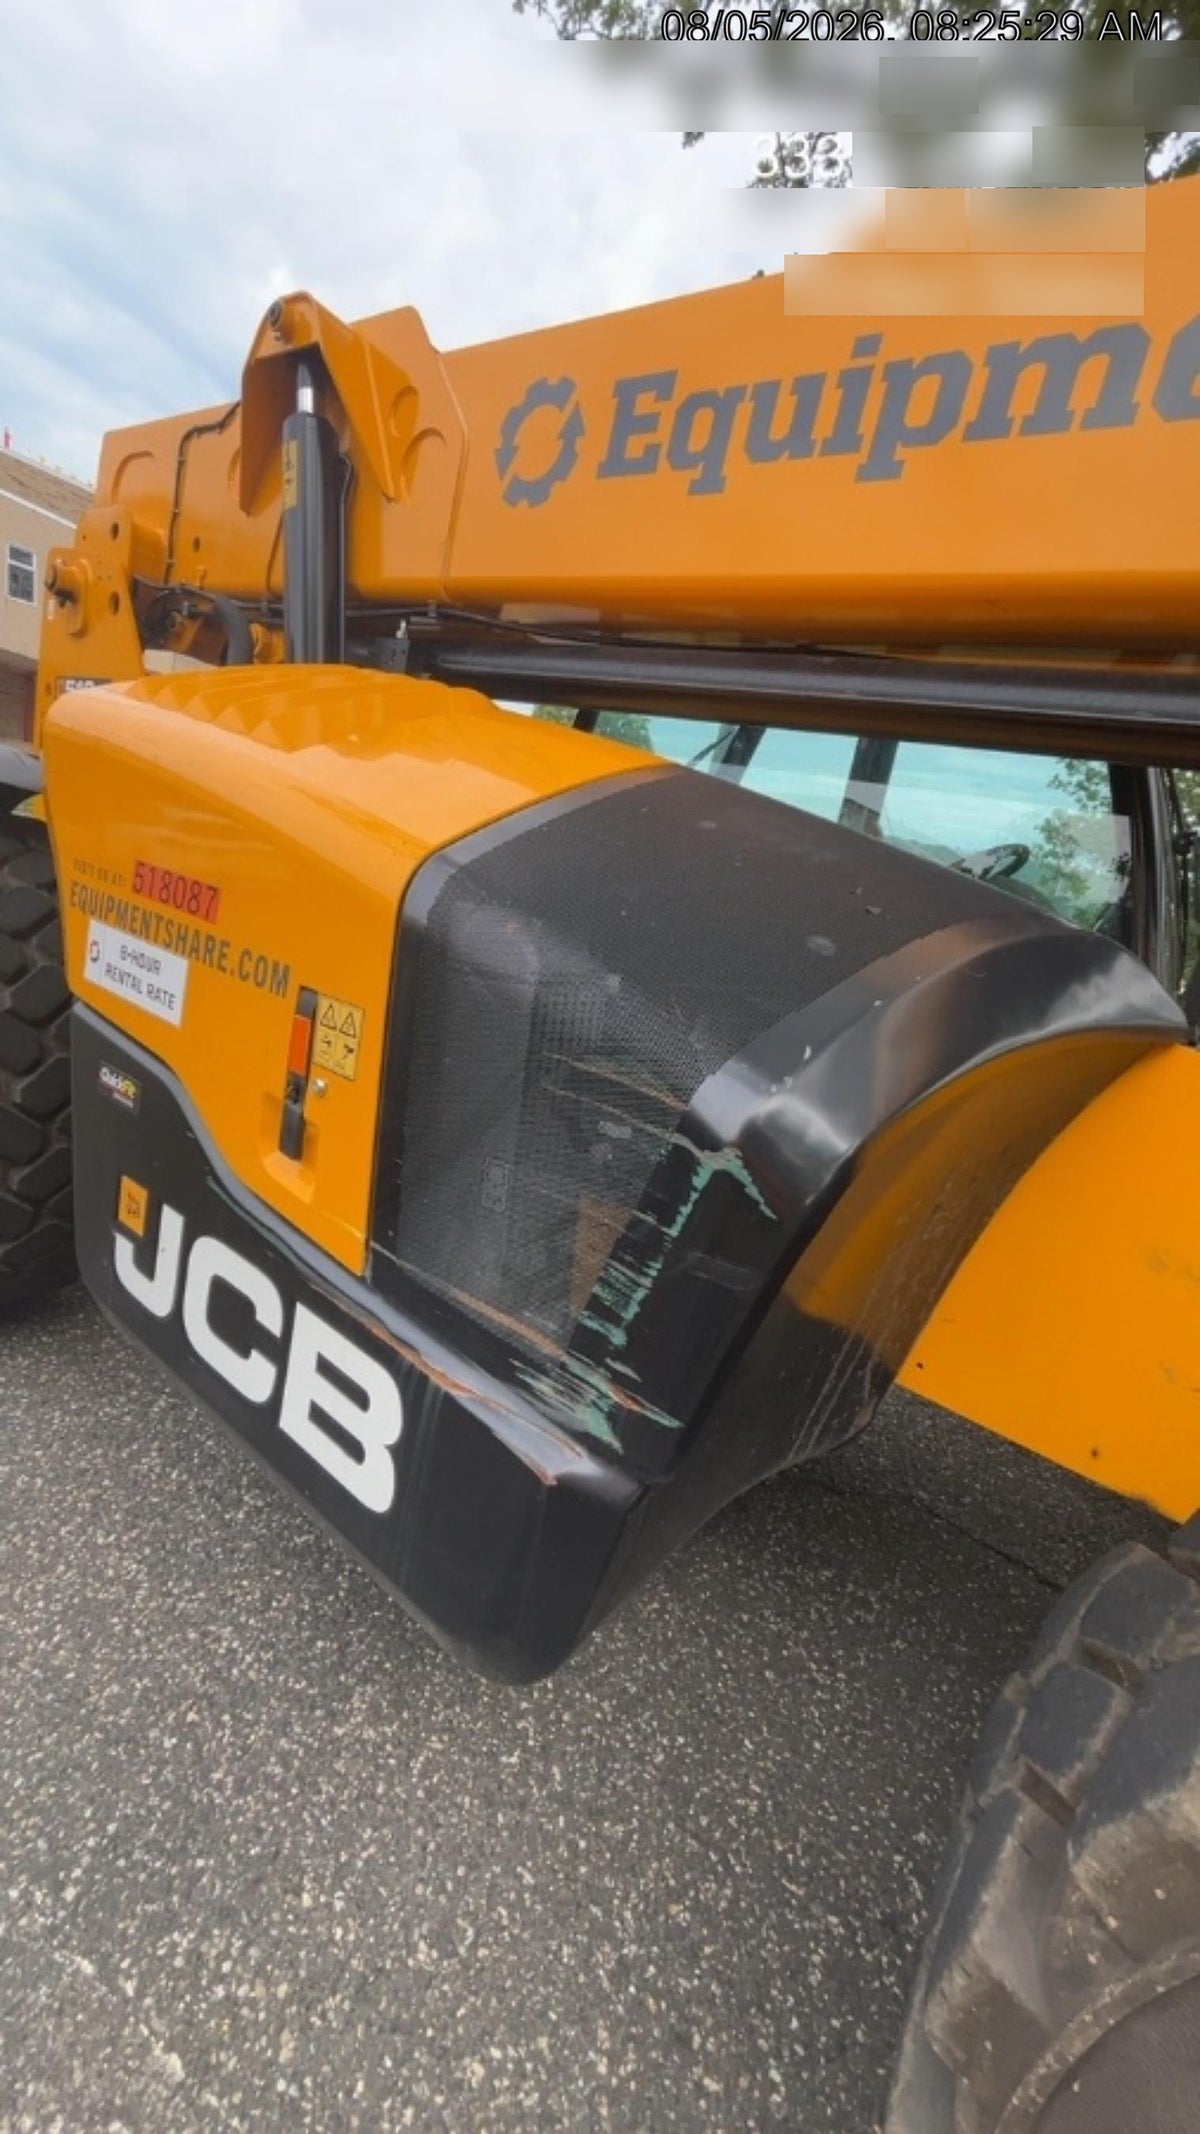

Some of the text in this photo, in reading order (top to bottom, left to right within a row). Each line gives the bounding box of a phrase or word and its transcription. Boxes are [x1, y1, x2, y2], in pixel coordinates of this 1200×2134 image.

[133, 859, 218, 920] 518087
[70, 880, 291, 998] EQUIPMENTSHARE.COM
[104, 962, 176, 1011] RENTAL RATE
[113, 1203, 403, 1514] JCB
